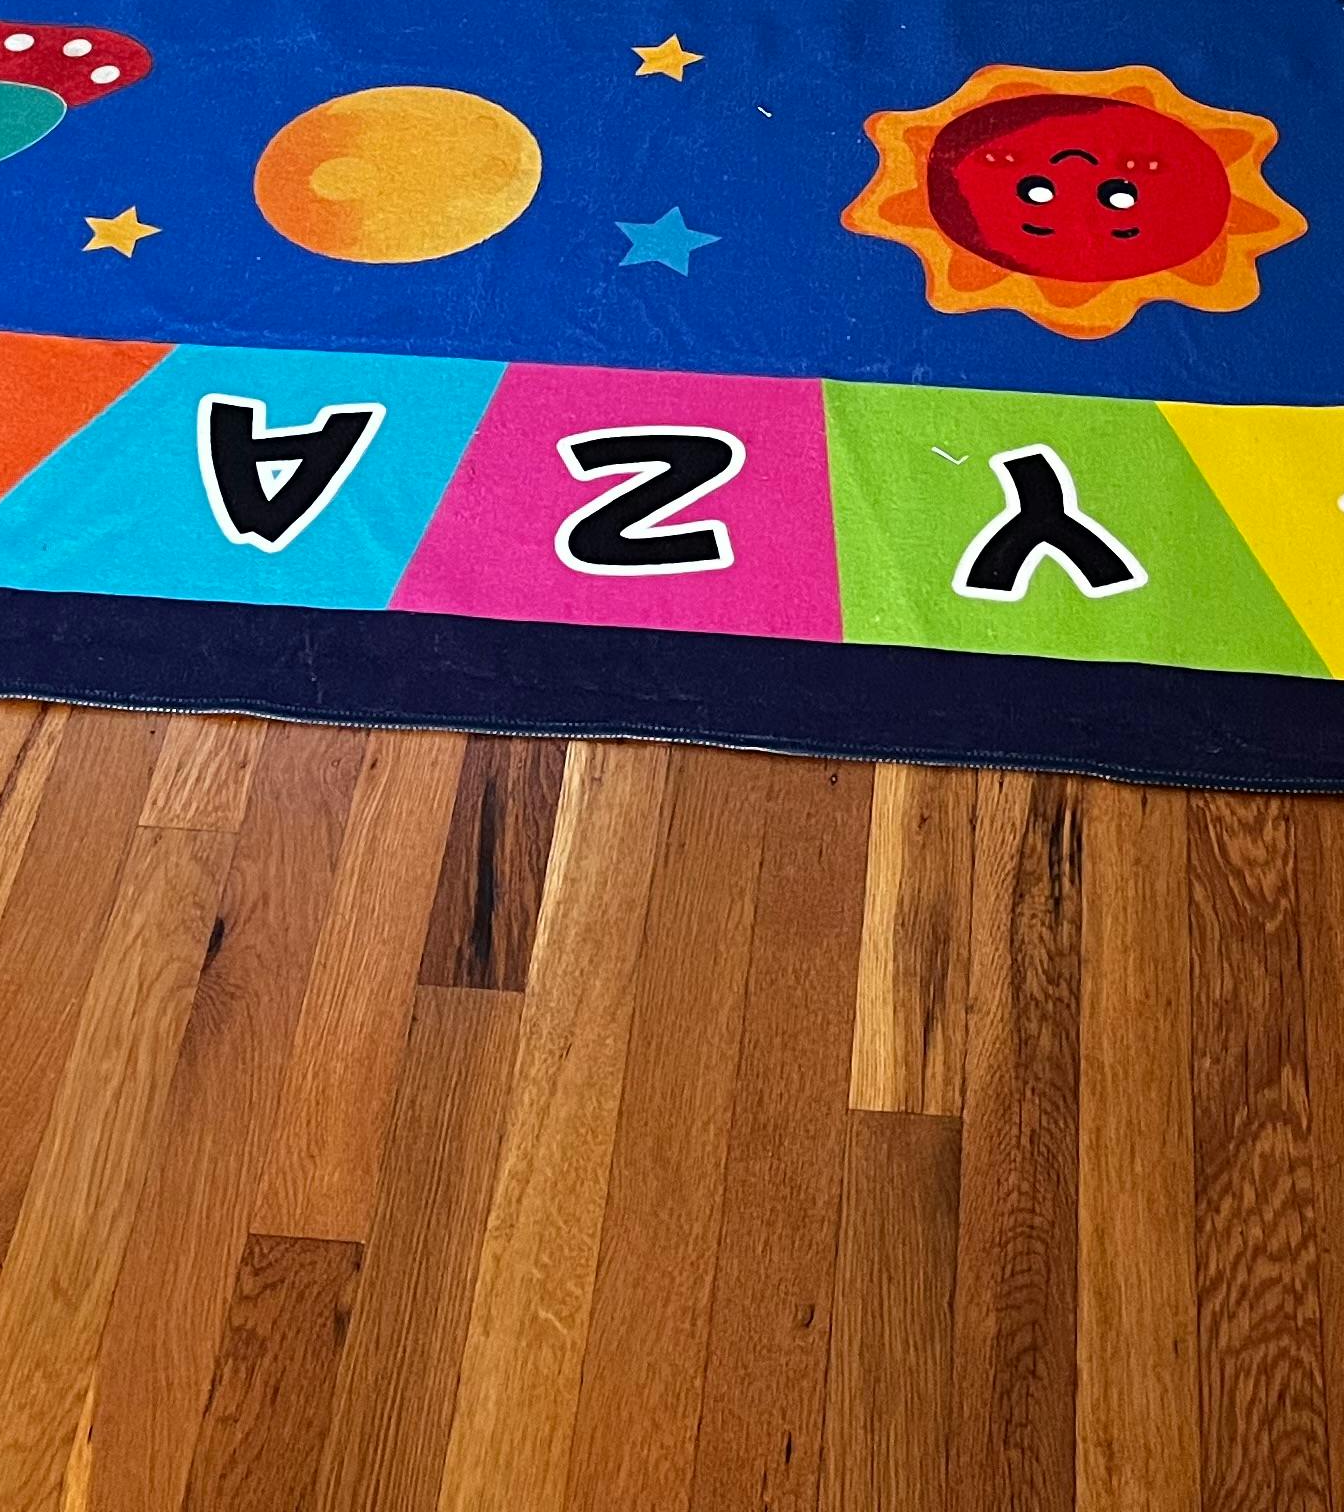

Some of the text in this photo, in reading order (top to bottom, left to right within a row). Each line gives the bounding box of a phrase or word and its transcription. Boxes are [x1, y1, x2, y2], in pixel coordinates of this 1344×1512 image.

[195, 393, 385, 552] A
[551, 421, 736, 573] Z
[953, 443, 1147, 599] Y
